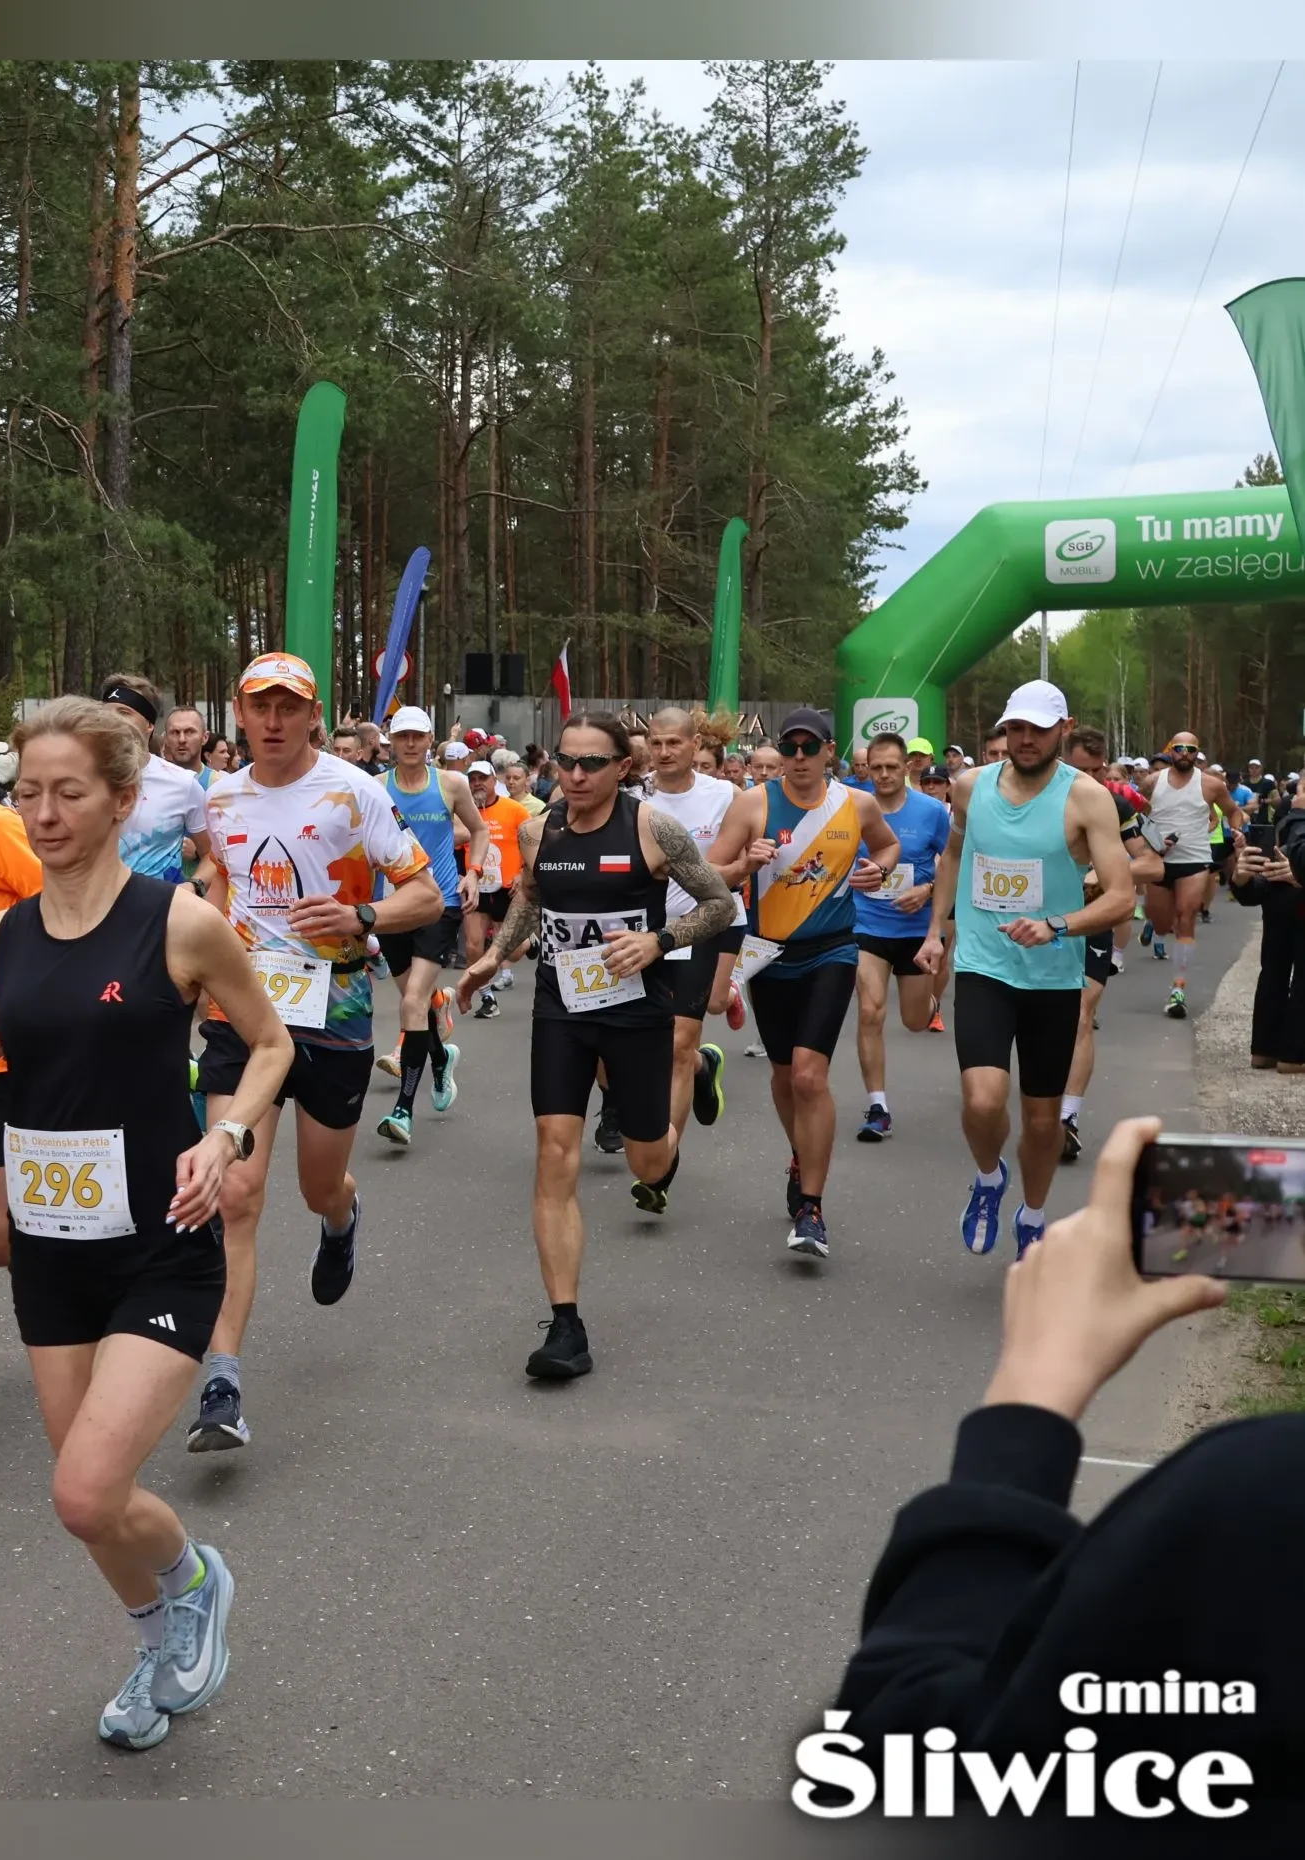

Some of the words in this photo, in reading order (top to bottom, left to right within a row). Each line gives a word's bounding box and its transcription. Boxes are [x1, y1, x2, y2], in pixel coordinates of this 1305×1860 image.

[1136, 515, 1172, 541] Tu
[1183, 512, 1284, 541] mamy
[1067, 541, 1093, 551] SGB
[1059, 566, 1102, 576] MOBILE
[1135, 558, 1165, 579] w
[1175, 547, 1305, 581] zasięgu
[872, 722, 897, 731] SGB
[538, 862, 586, 871] SEBASTIAN
[982, 871, 1029, 898] 109
[20, 1160, 103, 1208] 296
